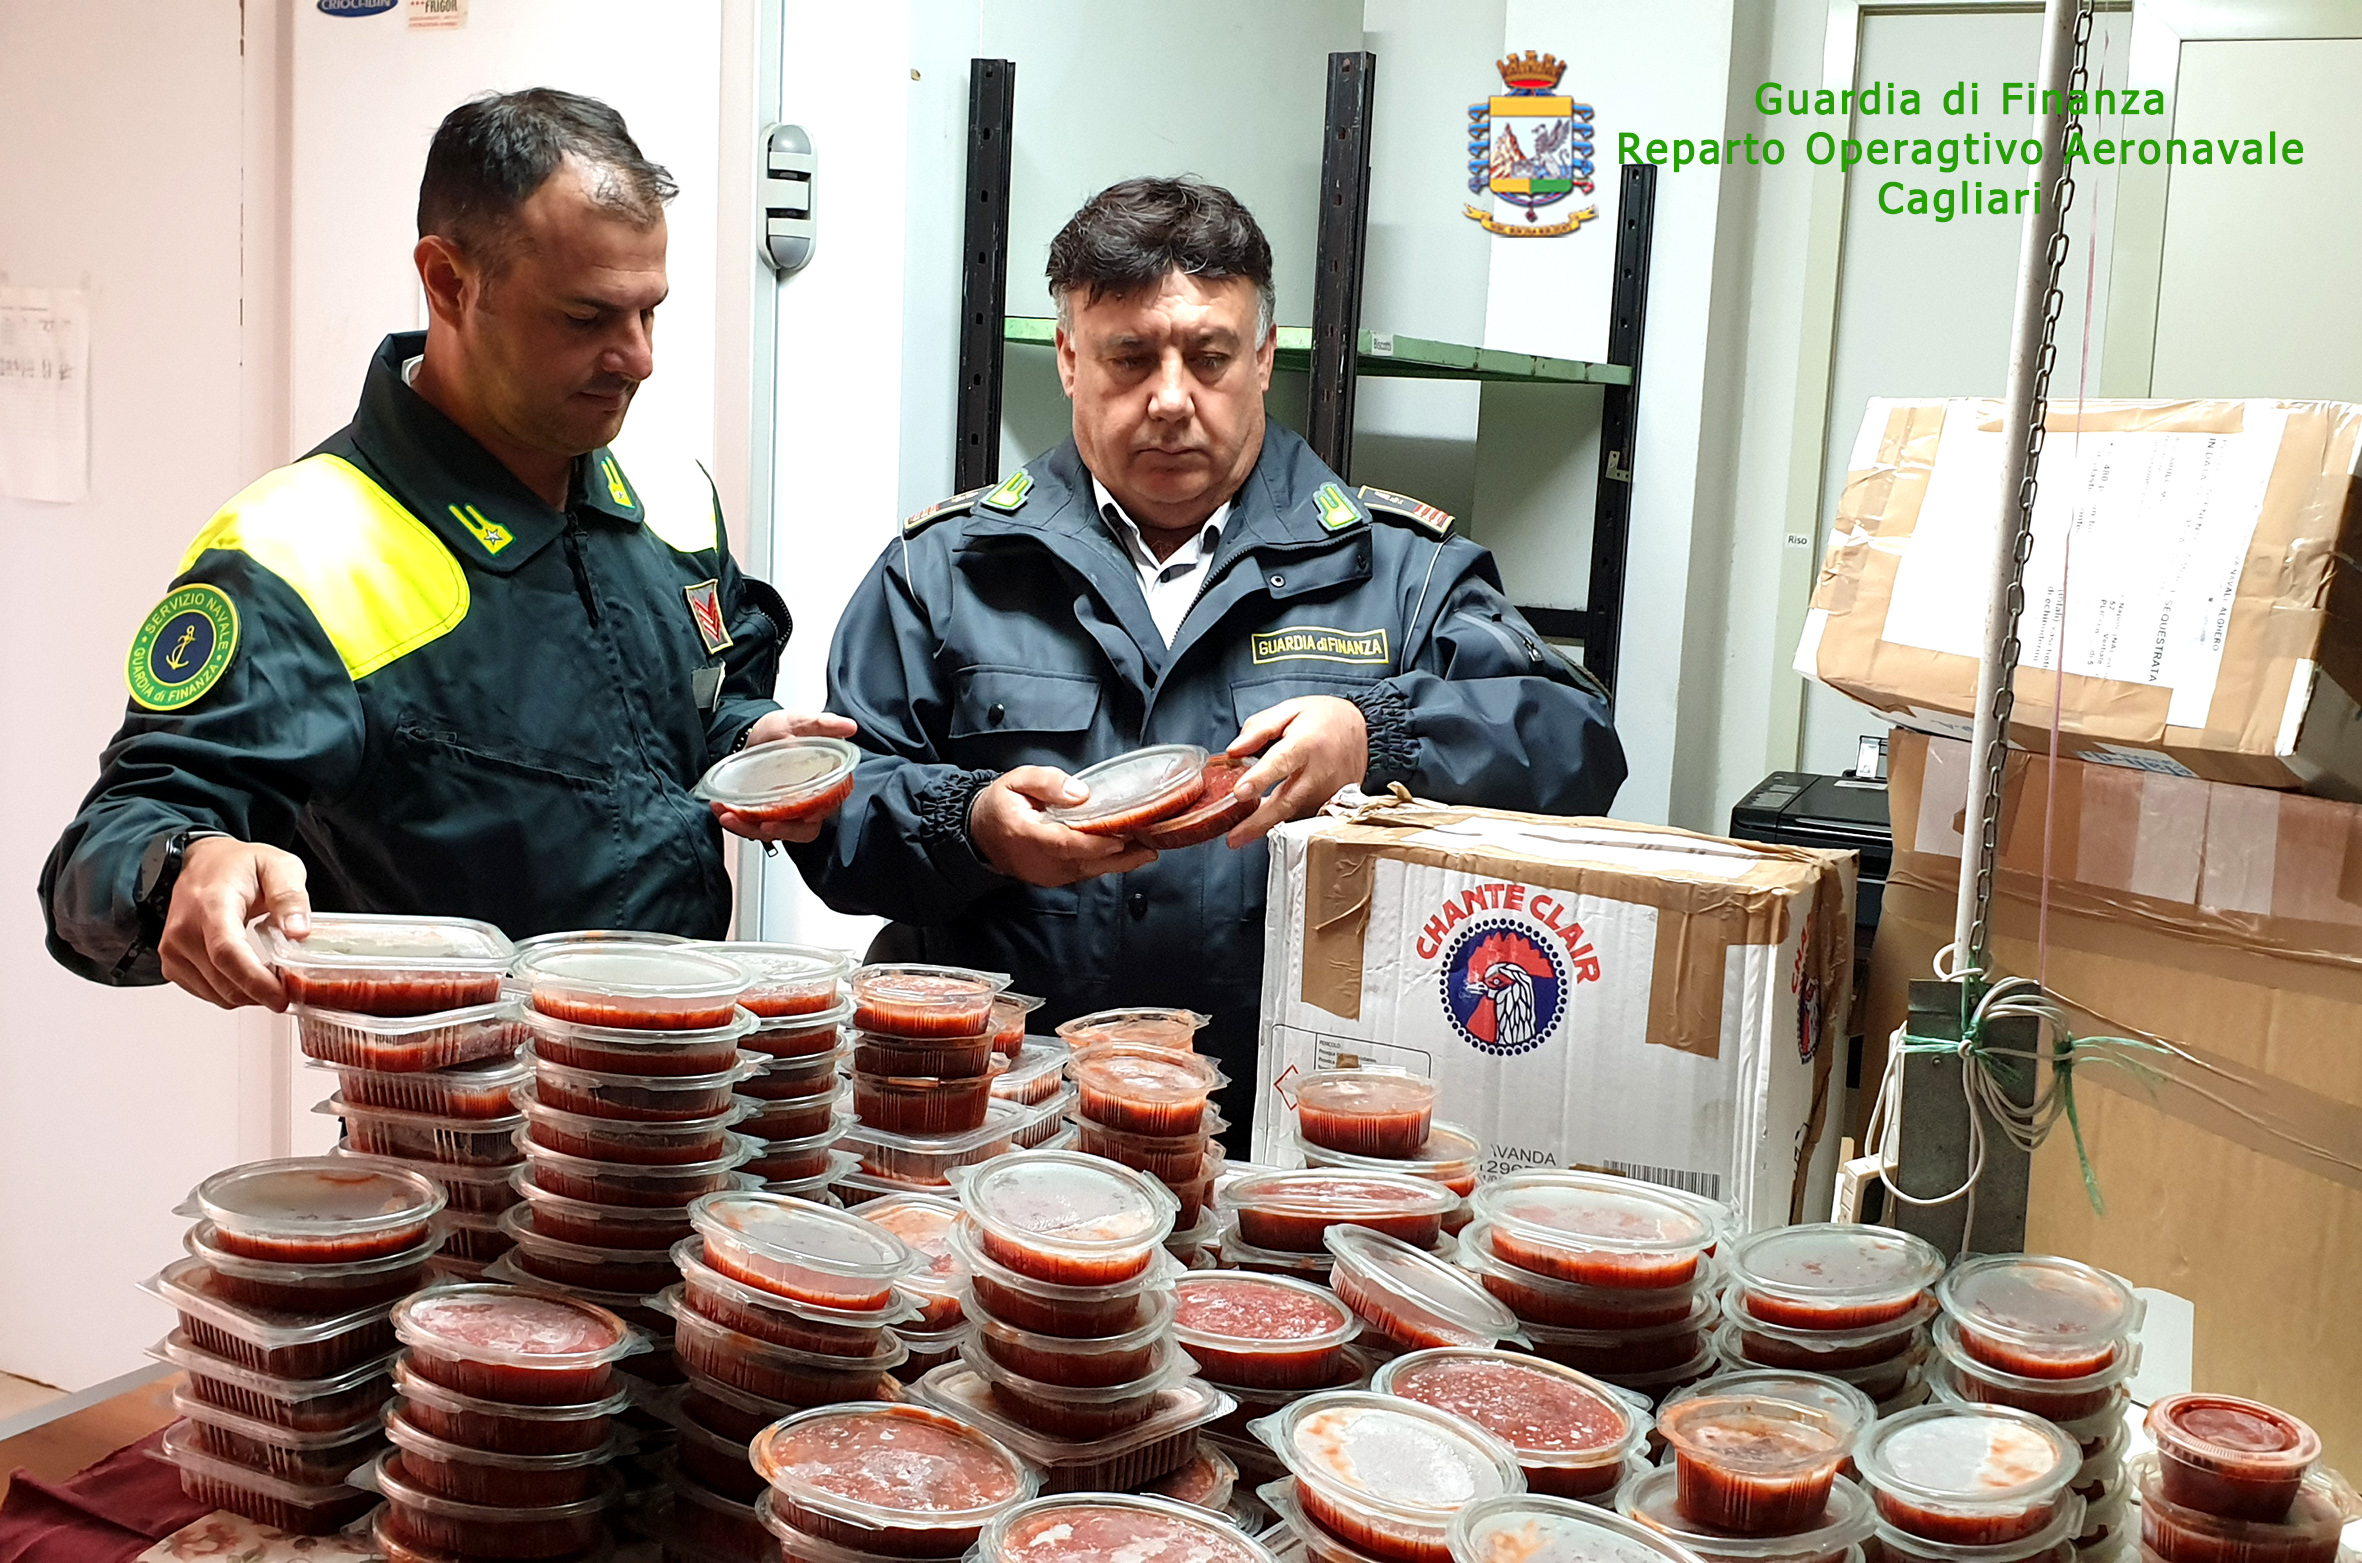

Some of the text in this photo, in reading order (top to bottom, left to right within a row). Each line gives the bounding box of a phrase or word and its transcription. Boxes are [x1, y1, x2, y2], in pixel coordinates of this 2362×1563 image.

[2207, 438, 2217, 449] IN
[1788, 535, 1808, 545] Riso
[145, 593, 230, 650] SERVIZIO NAVALE
[1259, 634, 1316, 656] GUARDIA
[1328, 637, 1383, 656] FINANZA
[2148, 599, 2173, 682] SEQUESTRATA
[2212, 606, 2227, 652] ALGHERO
[132, 647, 219, 702] GUARDIA di FINANZA
[1416, 883, 1601, 985] CHANTE CLAIR
